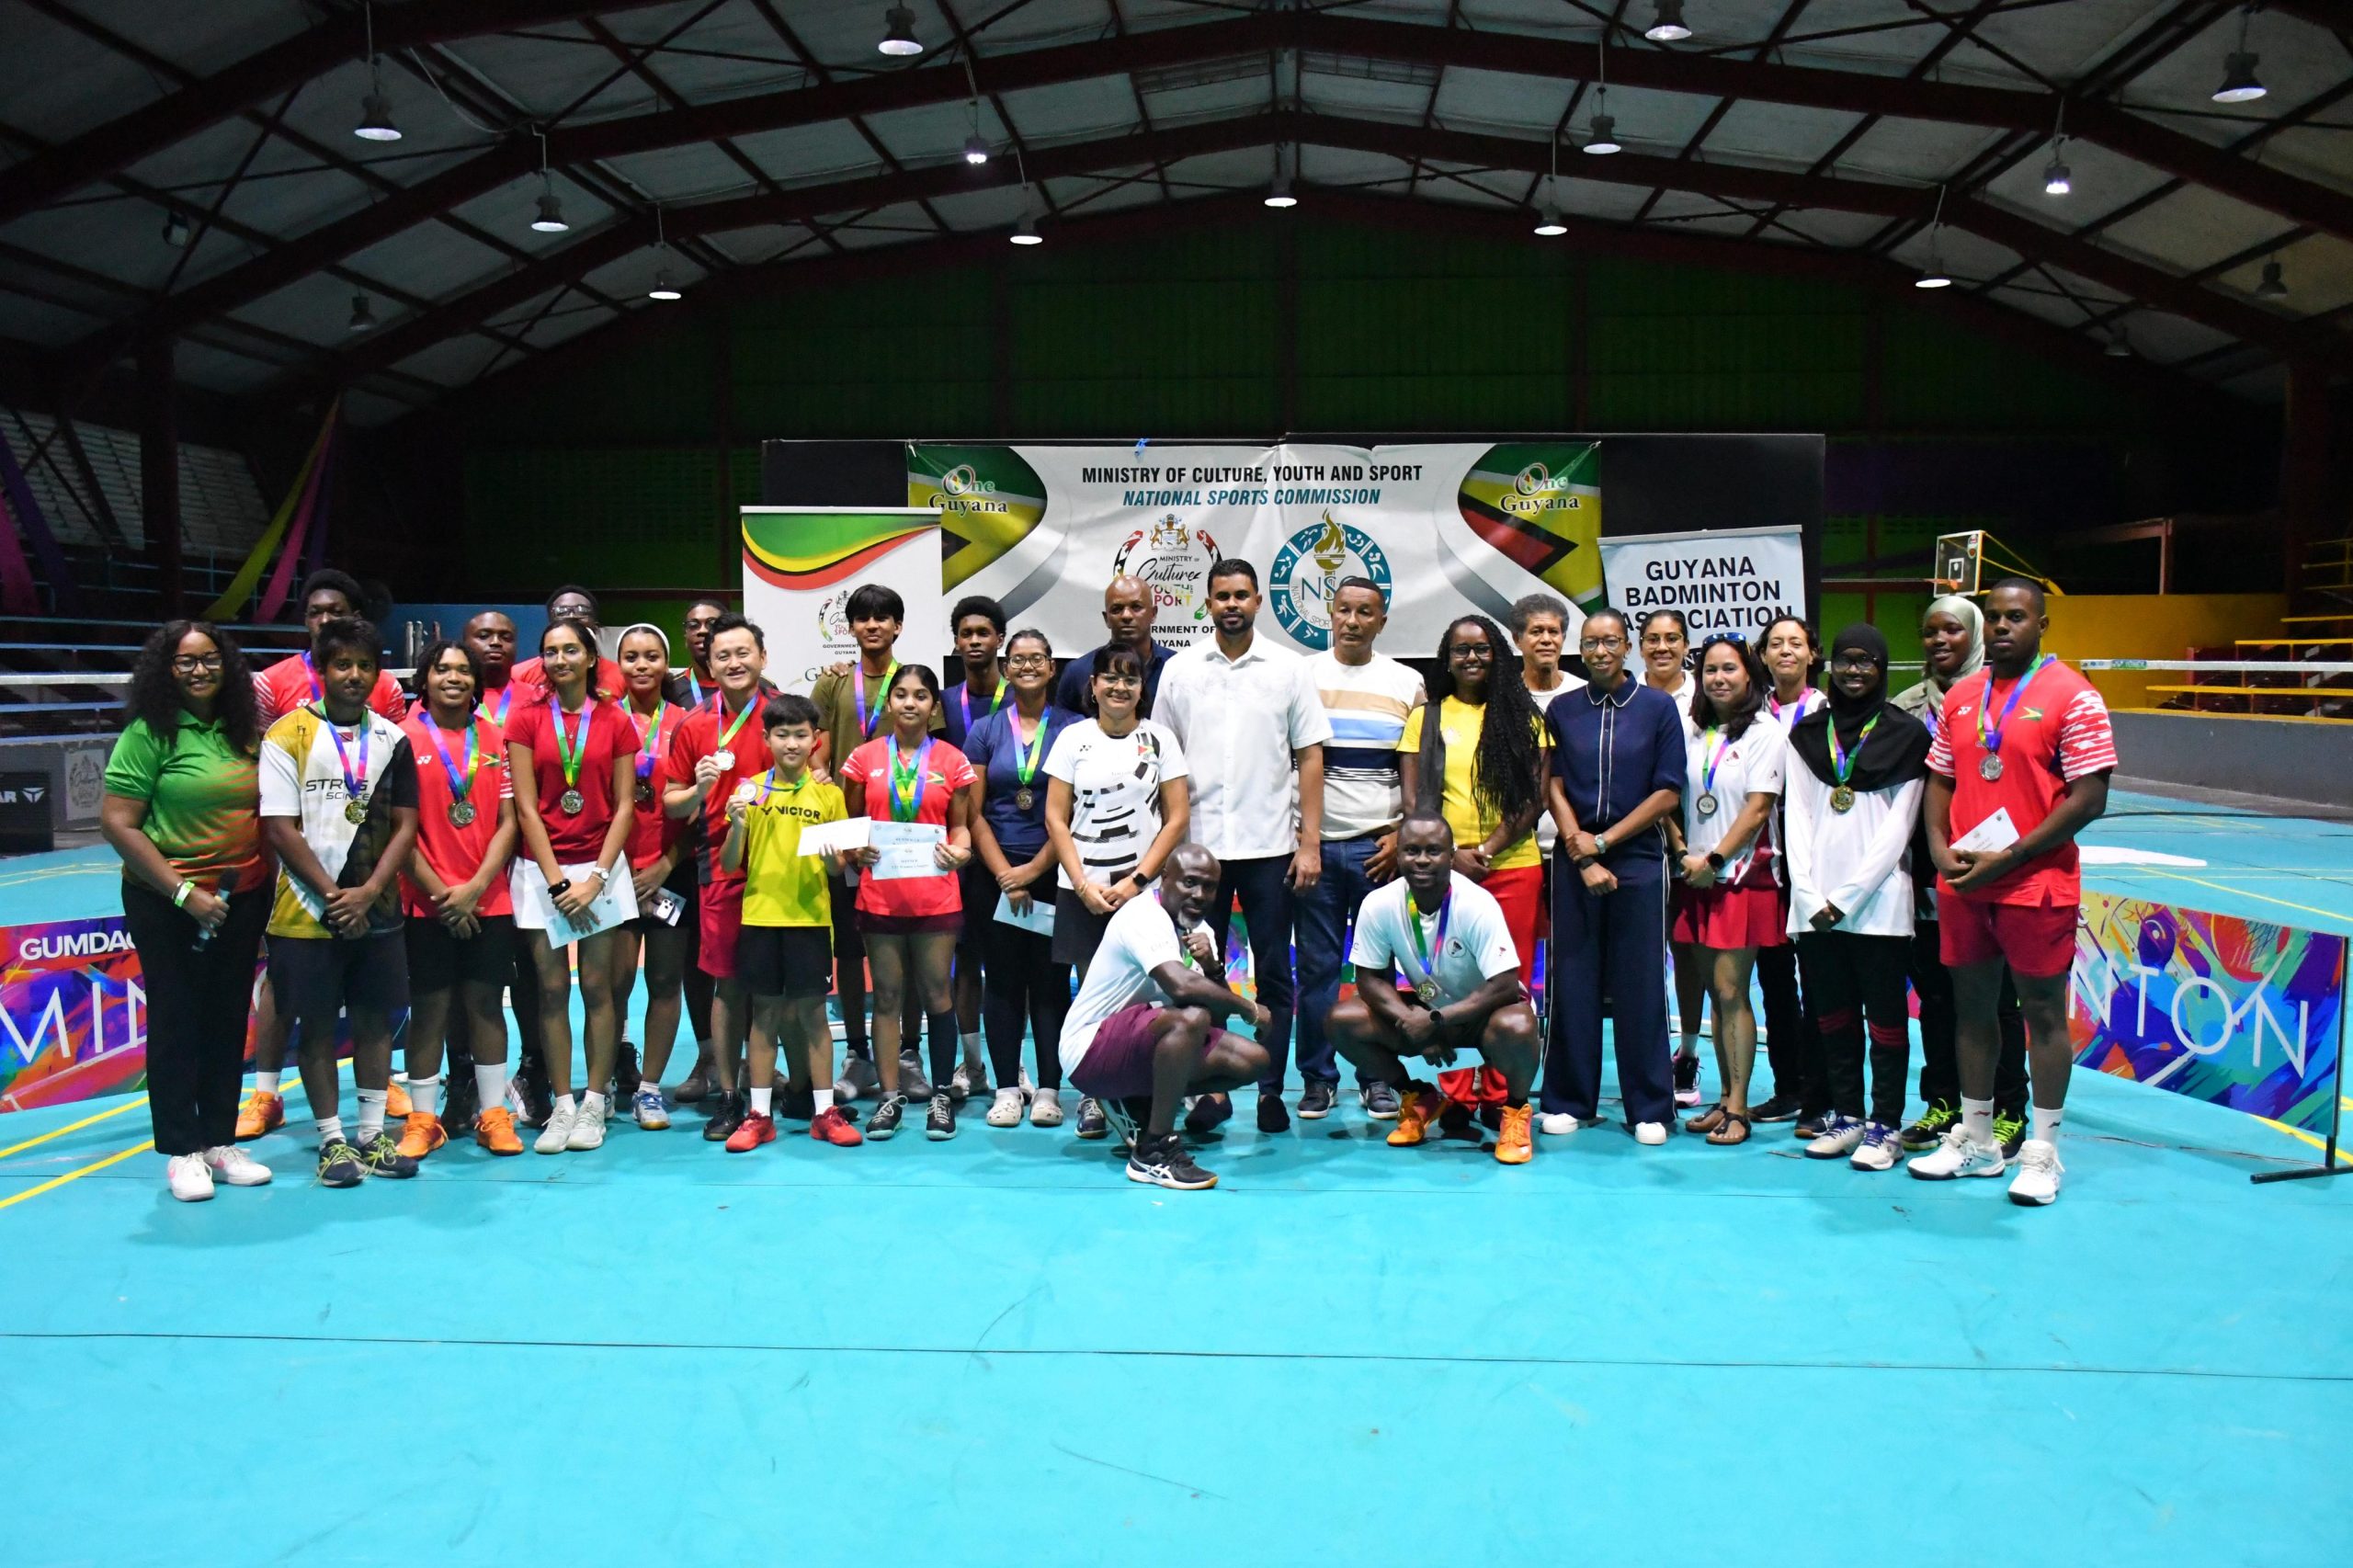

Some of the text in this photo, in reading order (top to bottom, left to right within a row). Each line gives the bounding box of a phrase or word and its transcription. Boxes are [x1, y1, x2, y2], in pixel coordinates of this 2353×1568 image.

[943, 466, 995, 496] One
[1082, 465, 1422, 484] MINISTRY OF CULTURE, YOUTH AND SPORT
[1516, 463, 1567, 496] One
[928, 494, 1008, 517] Guyana
[1123, 488, 1381, 506] NATIONAL SPORTS COMMISSION
[1500, 495, 1580, 515] Guyana
[1645, 556, 1756, 581] GUYANA
[1625, 580, 1780, 607] BADMINTON
[1621, 605, 1792, 631] ASCIATION
[775, 805, 821, 820] VICTOR
